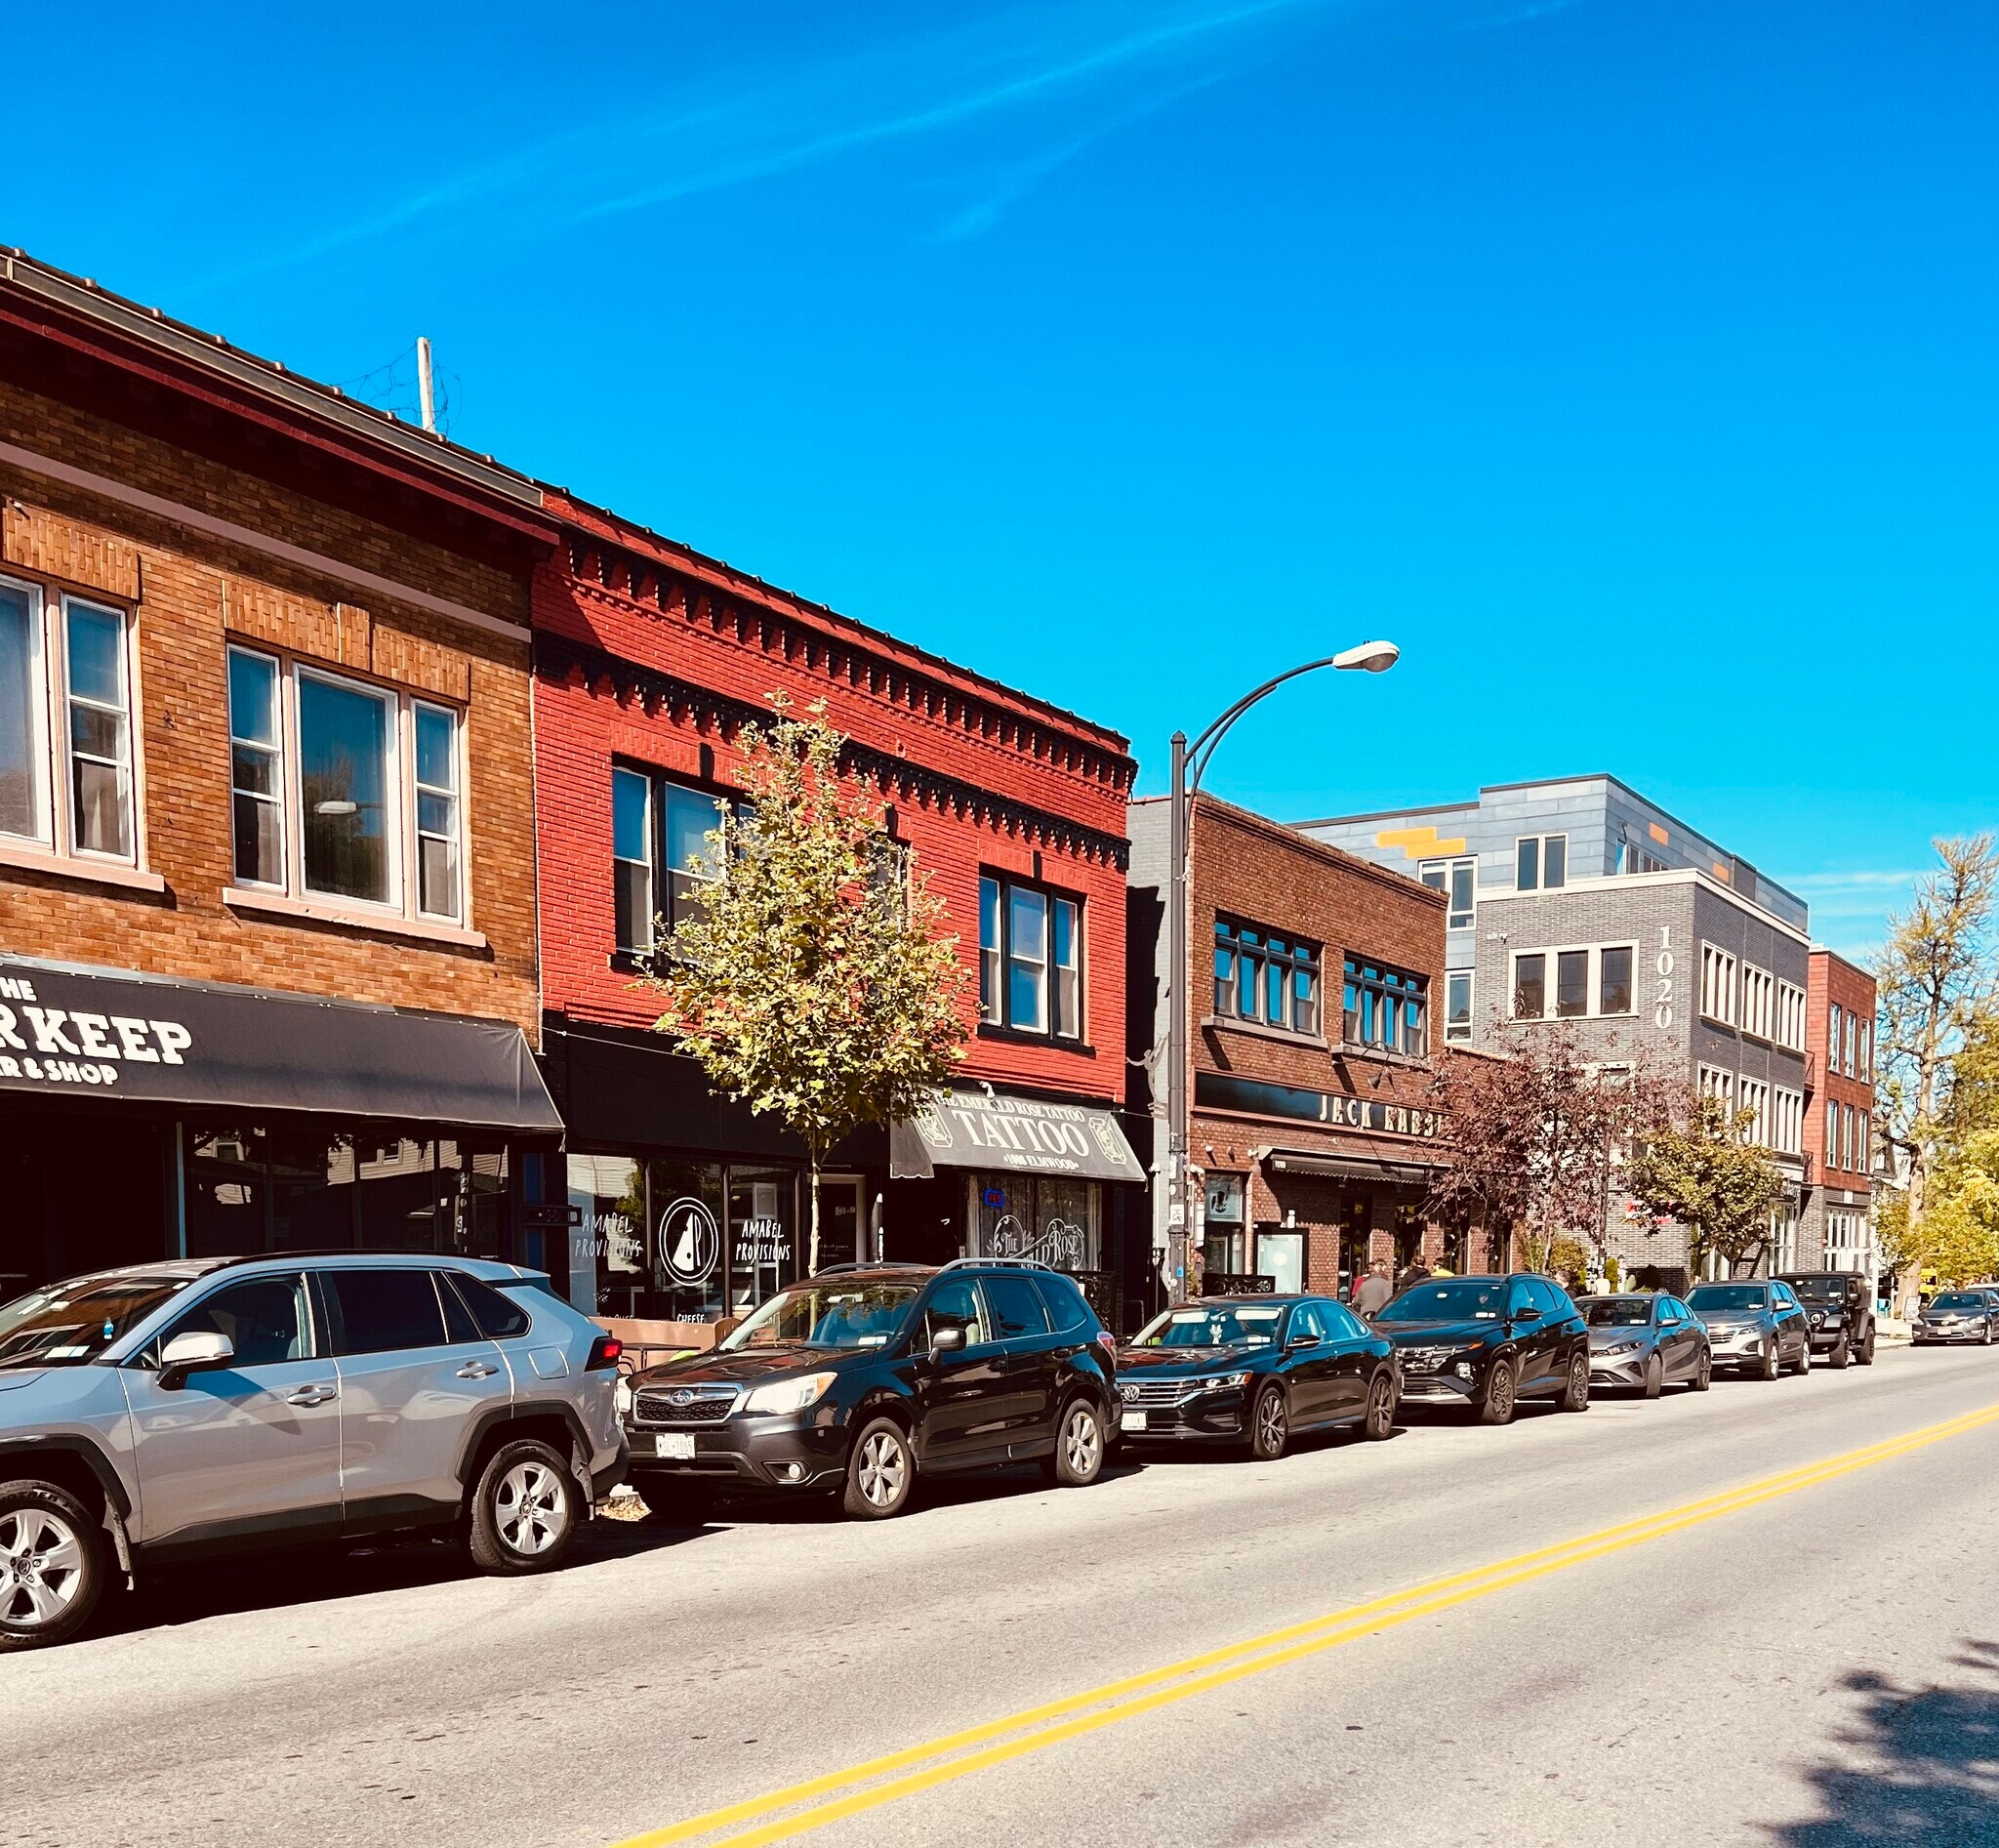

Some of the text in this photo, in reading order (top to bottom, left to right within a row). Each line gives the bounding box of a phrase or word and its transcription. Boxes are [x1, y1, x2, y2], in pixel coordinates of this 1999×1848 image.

[1655, 925, 1674, 1029] 1020
[23, 1057, 45, 1079] &
[44, 1059, 119, 1086] SHOP
[1013, 1101, 1045, 1117] ROSE
[1042, 1105, 1085, 1123] TATTOO
[1320, 1094, 1372, 1128] JACK
[952, 1110, 1089, 1157] TATTOO
[582, 1212, 633, 1233] AMABEL
[742, 1219, 785, 1239] AMABEL
[736, 1243, 792, 1261] PROVISIONS
